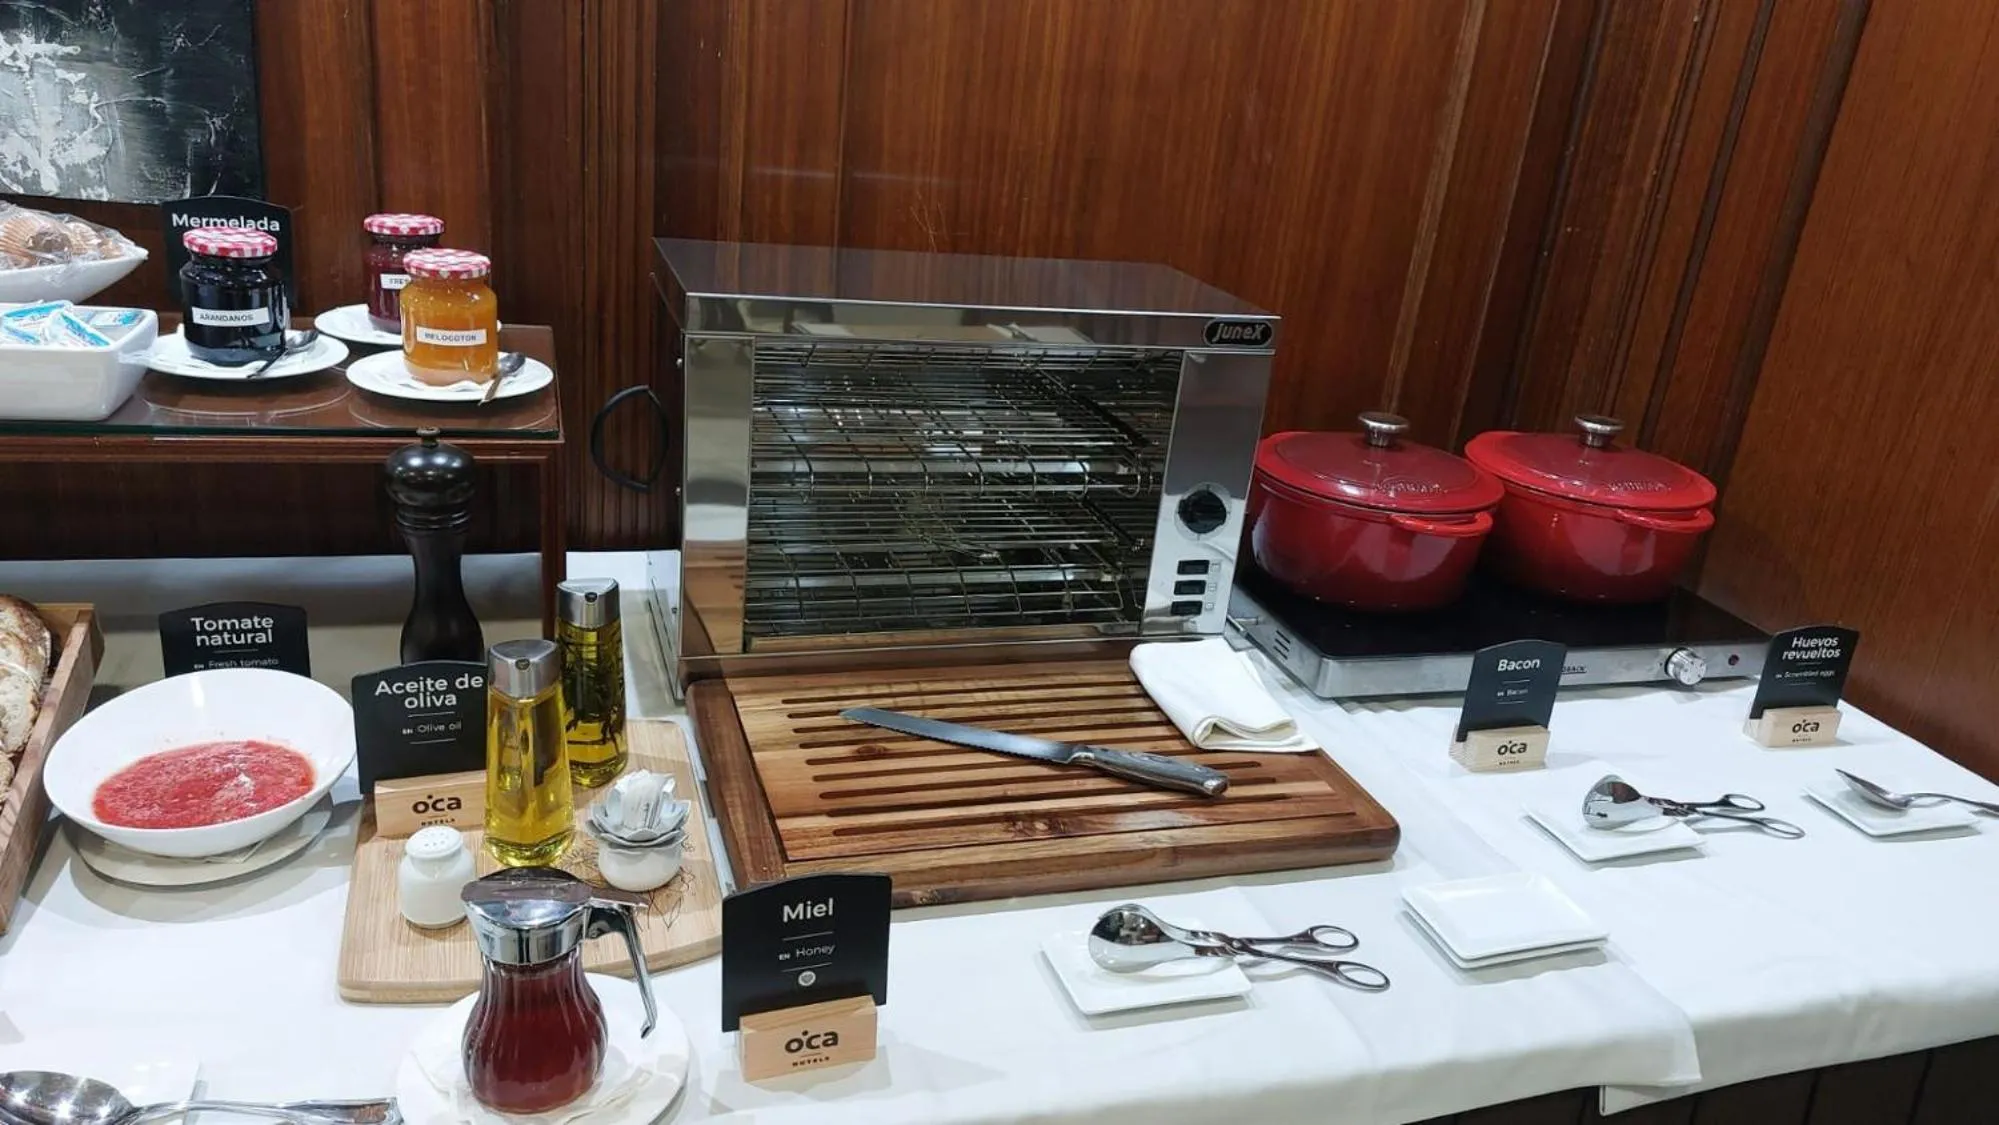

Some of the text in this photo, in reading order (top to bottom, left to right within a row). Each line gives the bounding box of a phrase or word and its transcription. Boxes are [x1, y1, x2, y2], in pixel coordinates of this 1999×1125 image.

[171, 213, 281, 232] Mermelada
[199, 313, 254, 322] ARANDANOS
[190, 615, 274, 632] Tomate
[195, 628, 273, 647] natural
[1791, 636, 1839, 649] Huevos
[1782, 647, 1841, 660] revueltos
[208, 658, 238, 669] Fresh
[240, 657, 279, 668] tomato
[1497, 659, 1540, 672] Bacon
[374, 673, 484, 696] Aceite de
[404, 692, 457, 709] oliva
[417, 724, 445, 734] Olive
[448, 720, 462, 731] oil
[782, 897, 834, 923] Miel
[778, 944, 836, 961] EN Honey
